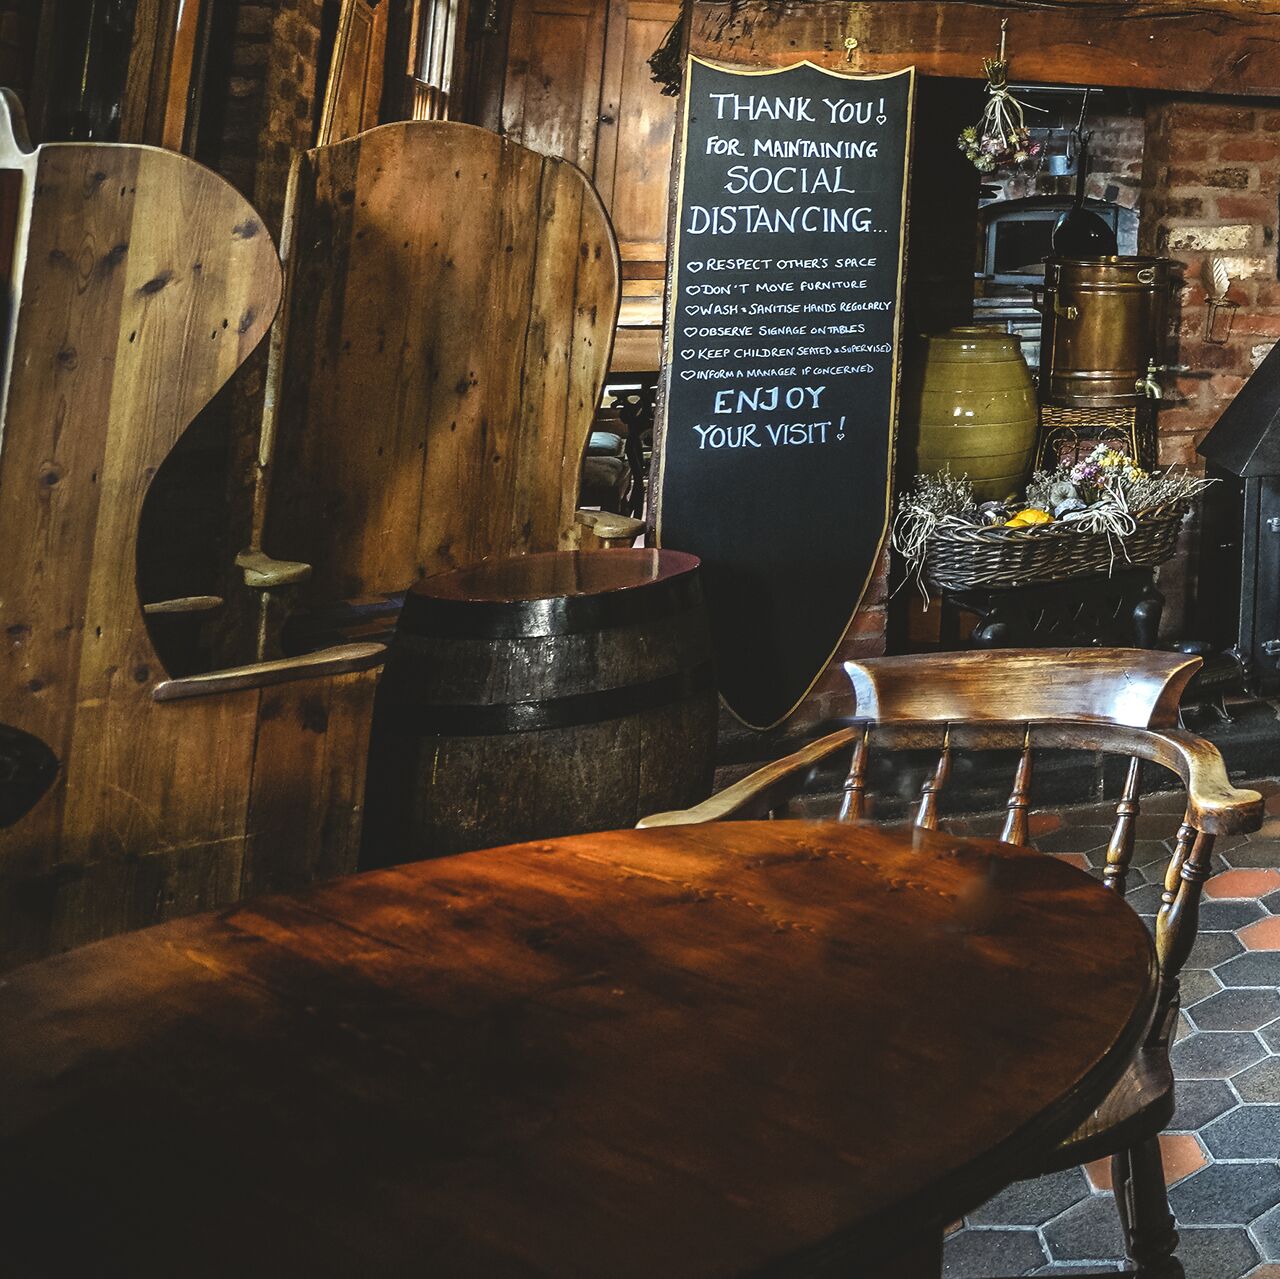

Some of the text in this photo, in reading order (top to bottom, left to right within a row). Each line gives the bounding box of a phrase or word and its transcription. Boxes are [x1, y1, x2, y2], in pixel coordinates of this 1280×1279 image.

[710, 93, 887, 125] THANK YOU!
[706, 136, 878, 159] FOR MAINTAINING
[724, 165, 856, 194] SOCIAL
[706, 257, 877, 270] RESPECT OTHER'S SPACE
[701, 280, 868, 296] DON'T MOVE FURNITURE
[700, 303, 738, 316] WASH
[748, 303, 800, 315] SANITISE
[803, 301, 837, 313] HANDS
[699, 323, 866, 338] OBSERVE SIGNAGE ON TABLES
[697, 348, 731, 361] KEEP
[733, 347, 795, 359] CHILDREN
[796, 345, 832, 356] SEATED
[840, 342, 892, 355] SUPERVISED
[697, 364, 874, 380] INFORM A MANAGER IF CONCERNED
[714, 385, 826, 414] ENJOY
[692, 423, 762, 449] YOUR
